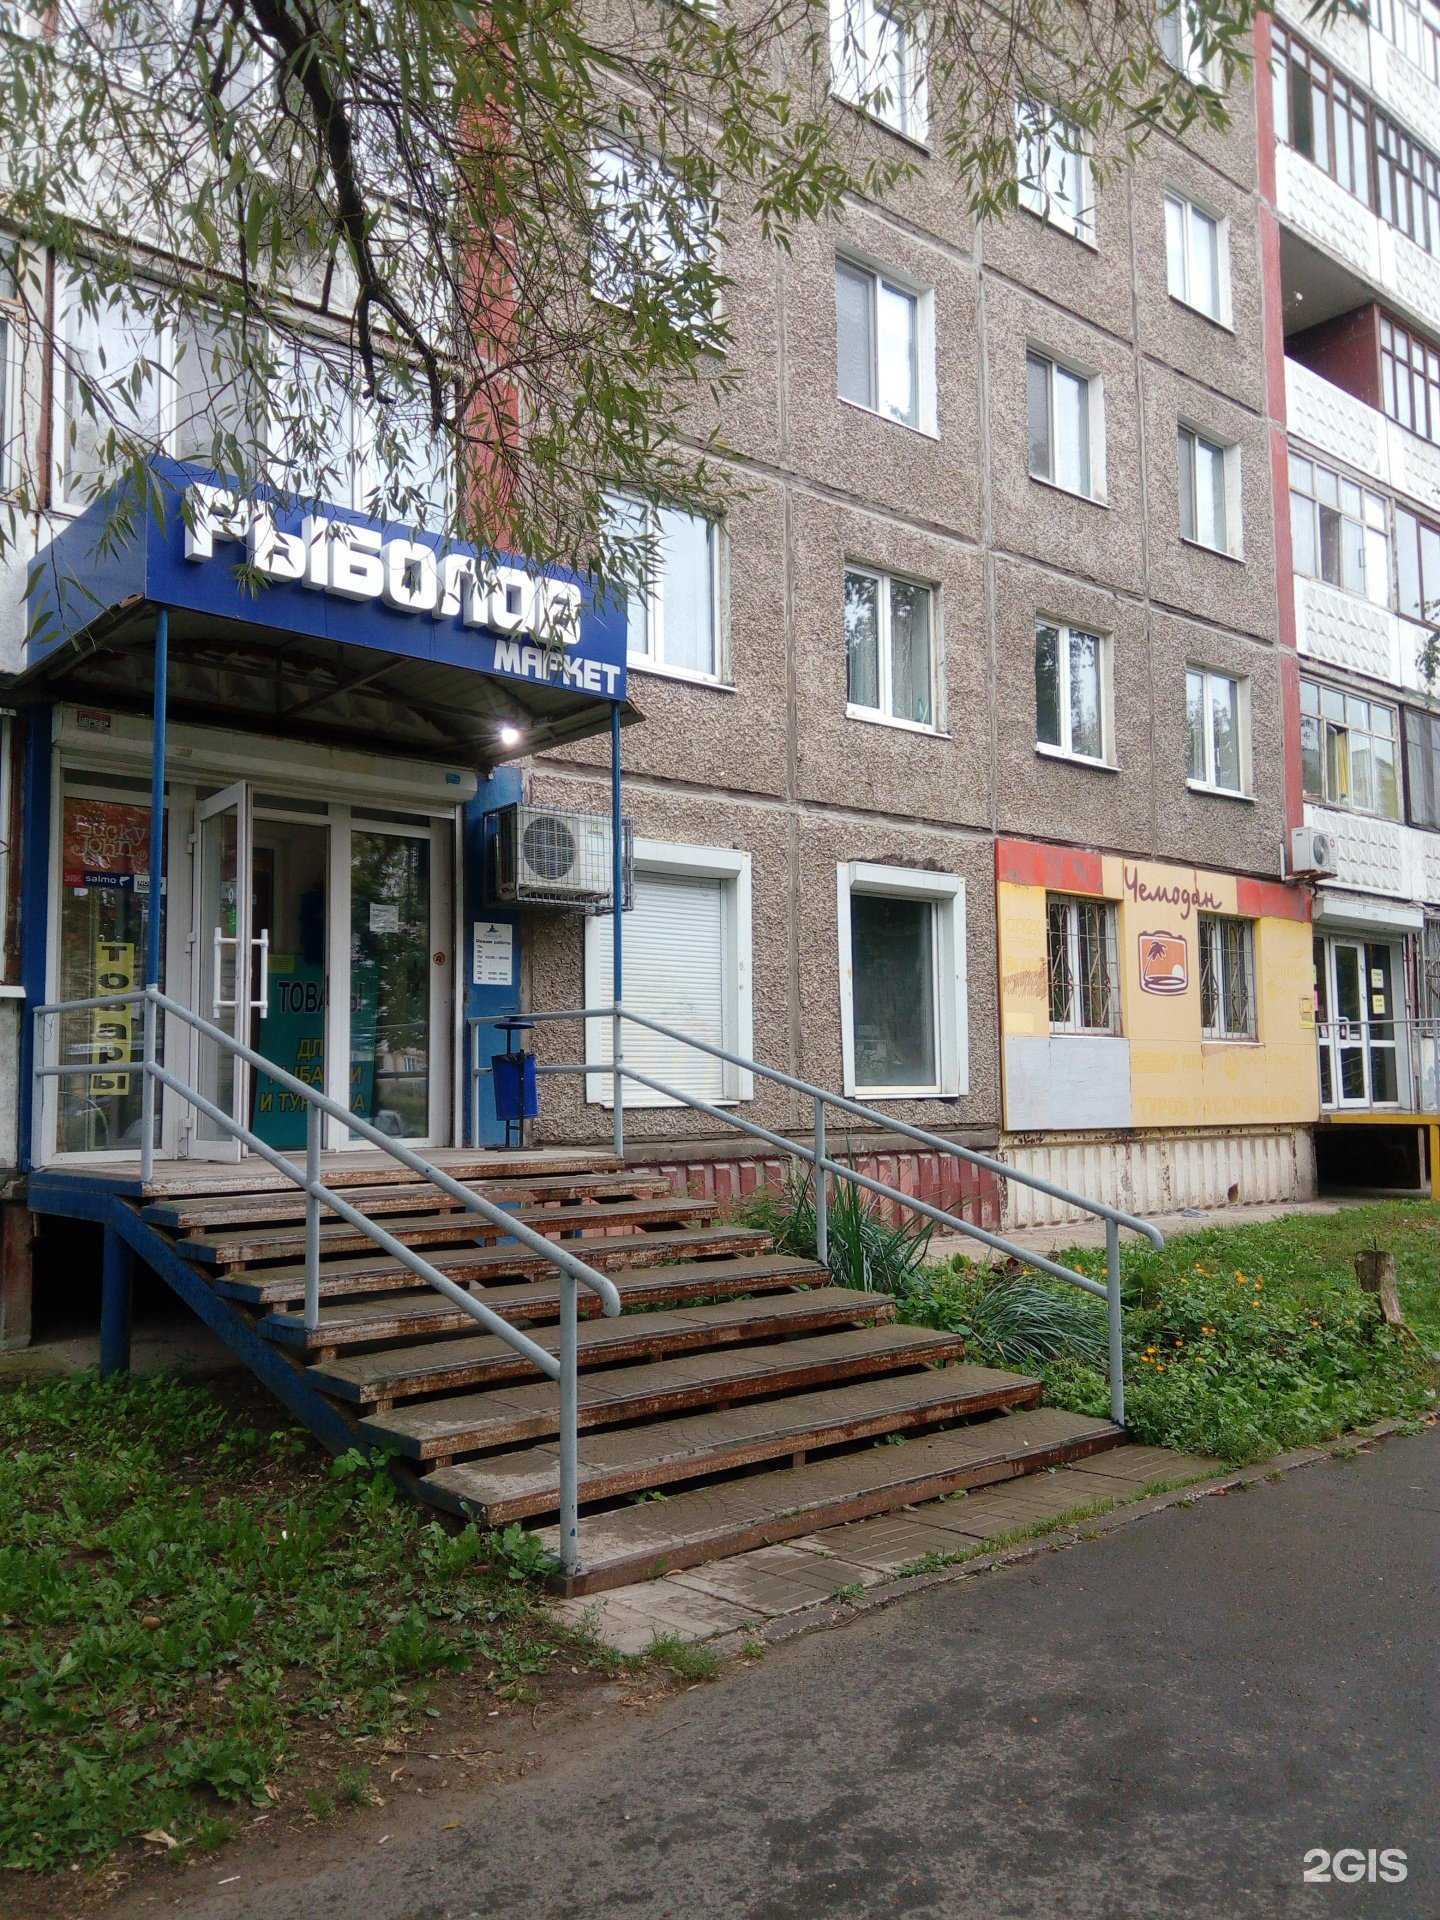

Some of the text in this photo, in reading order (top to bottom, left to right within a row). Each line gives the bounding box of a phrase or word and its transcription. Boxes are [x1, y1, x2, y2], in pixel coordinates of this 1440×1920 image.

[494, 639, 621, 695] МАРКЕТ
[86, 875, 117, 884] salmo
[1124, 864, 1223, 921] Чемодан
